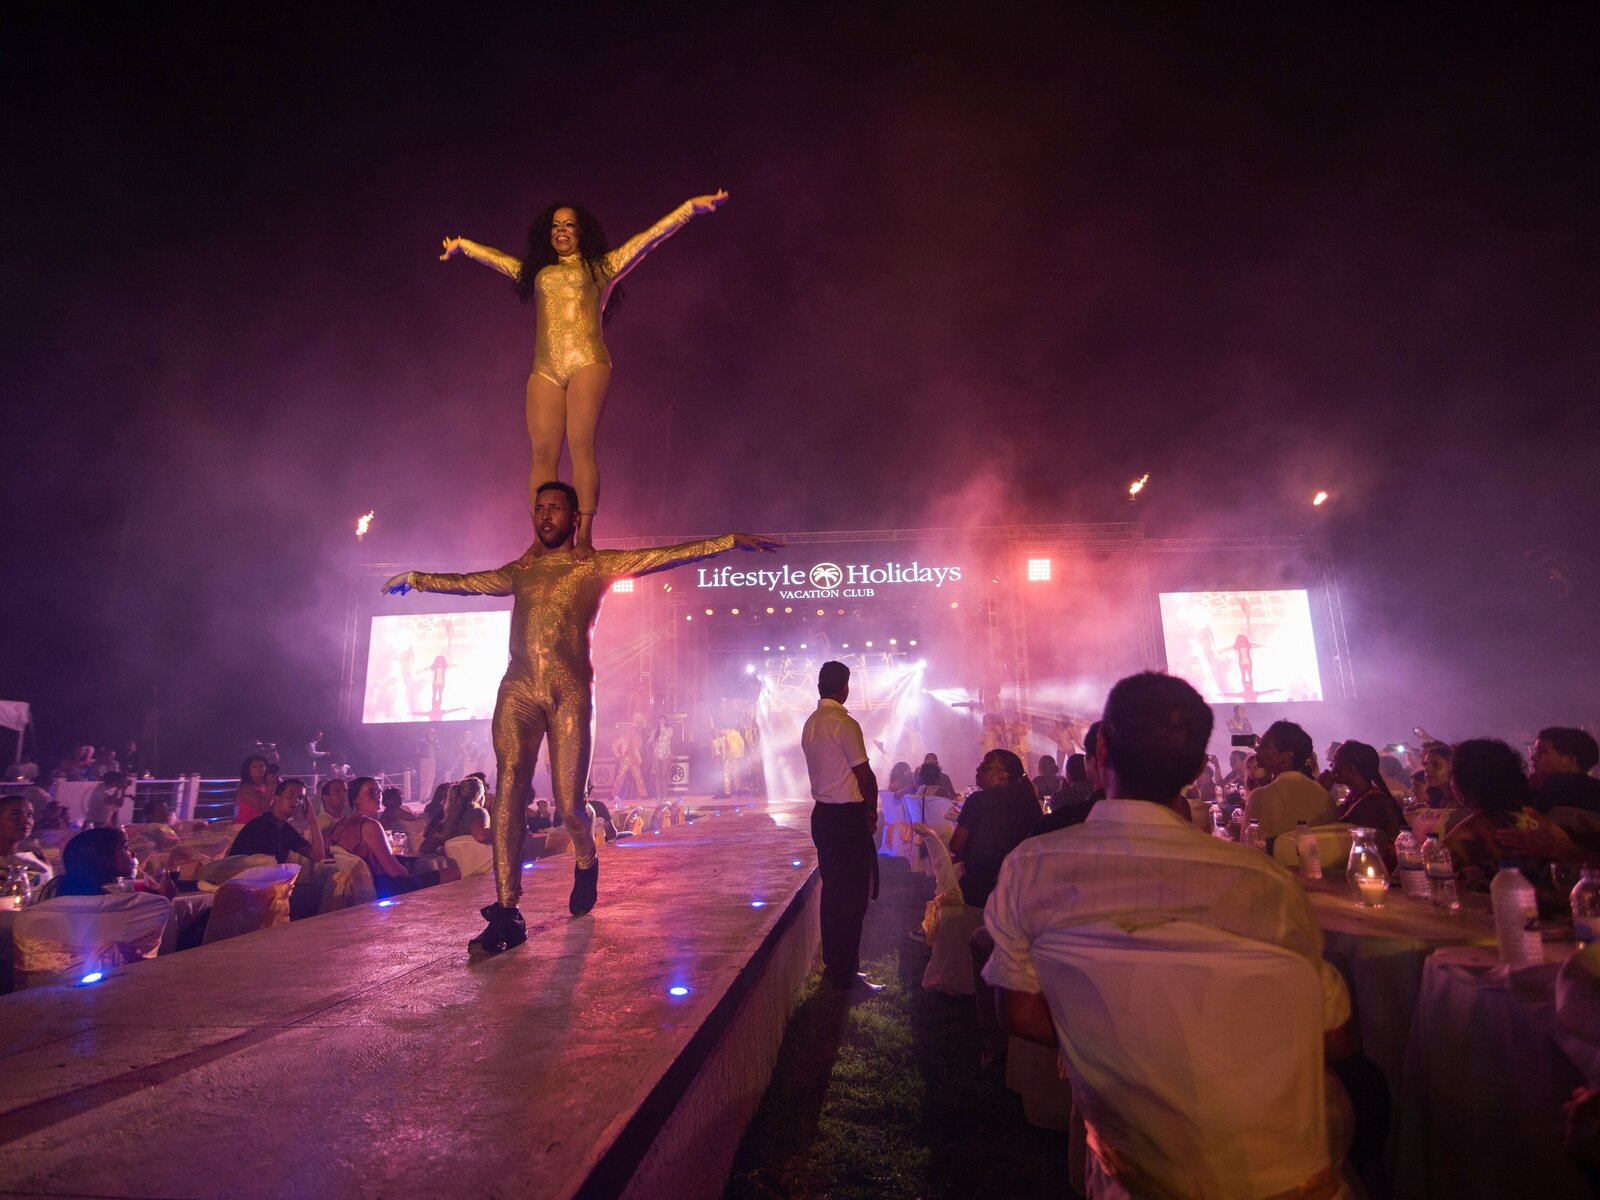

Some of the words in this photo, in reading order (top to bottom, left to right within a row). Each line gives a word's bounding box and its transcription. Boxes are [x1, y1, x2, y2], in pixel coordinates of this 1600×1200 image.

[698, 565, 806, 591] Lifestyle
[846, 562, 962, 588] Holidays
[780, 589, 840, 599] VACATION
[843, 588, 875, 598] CLUB
